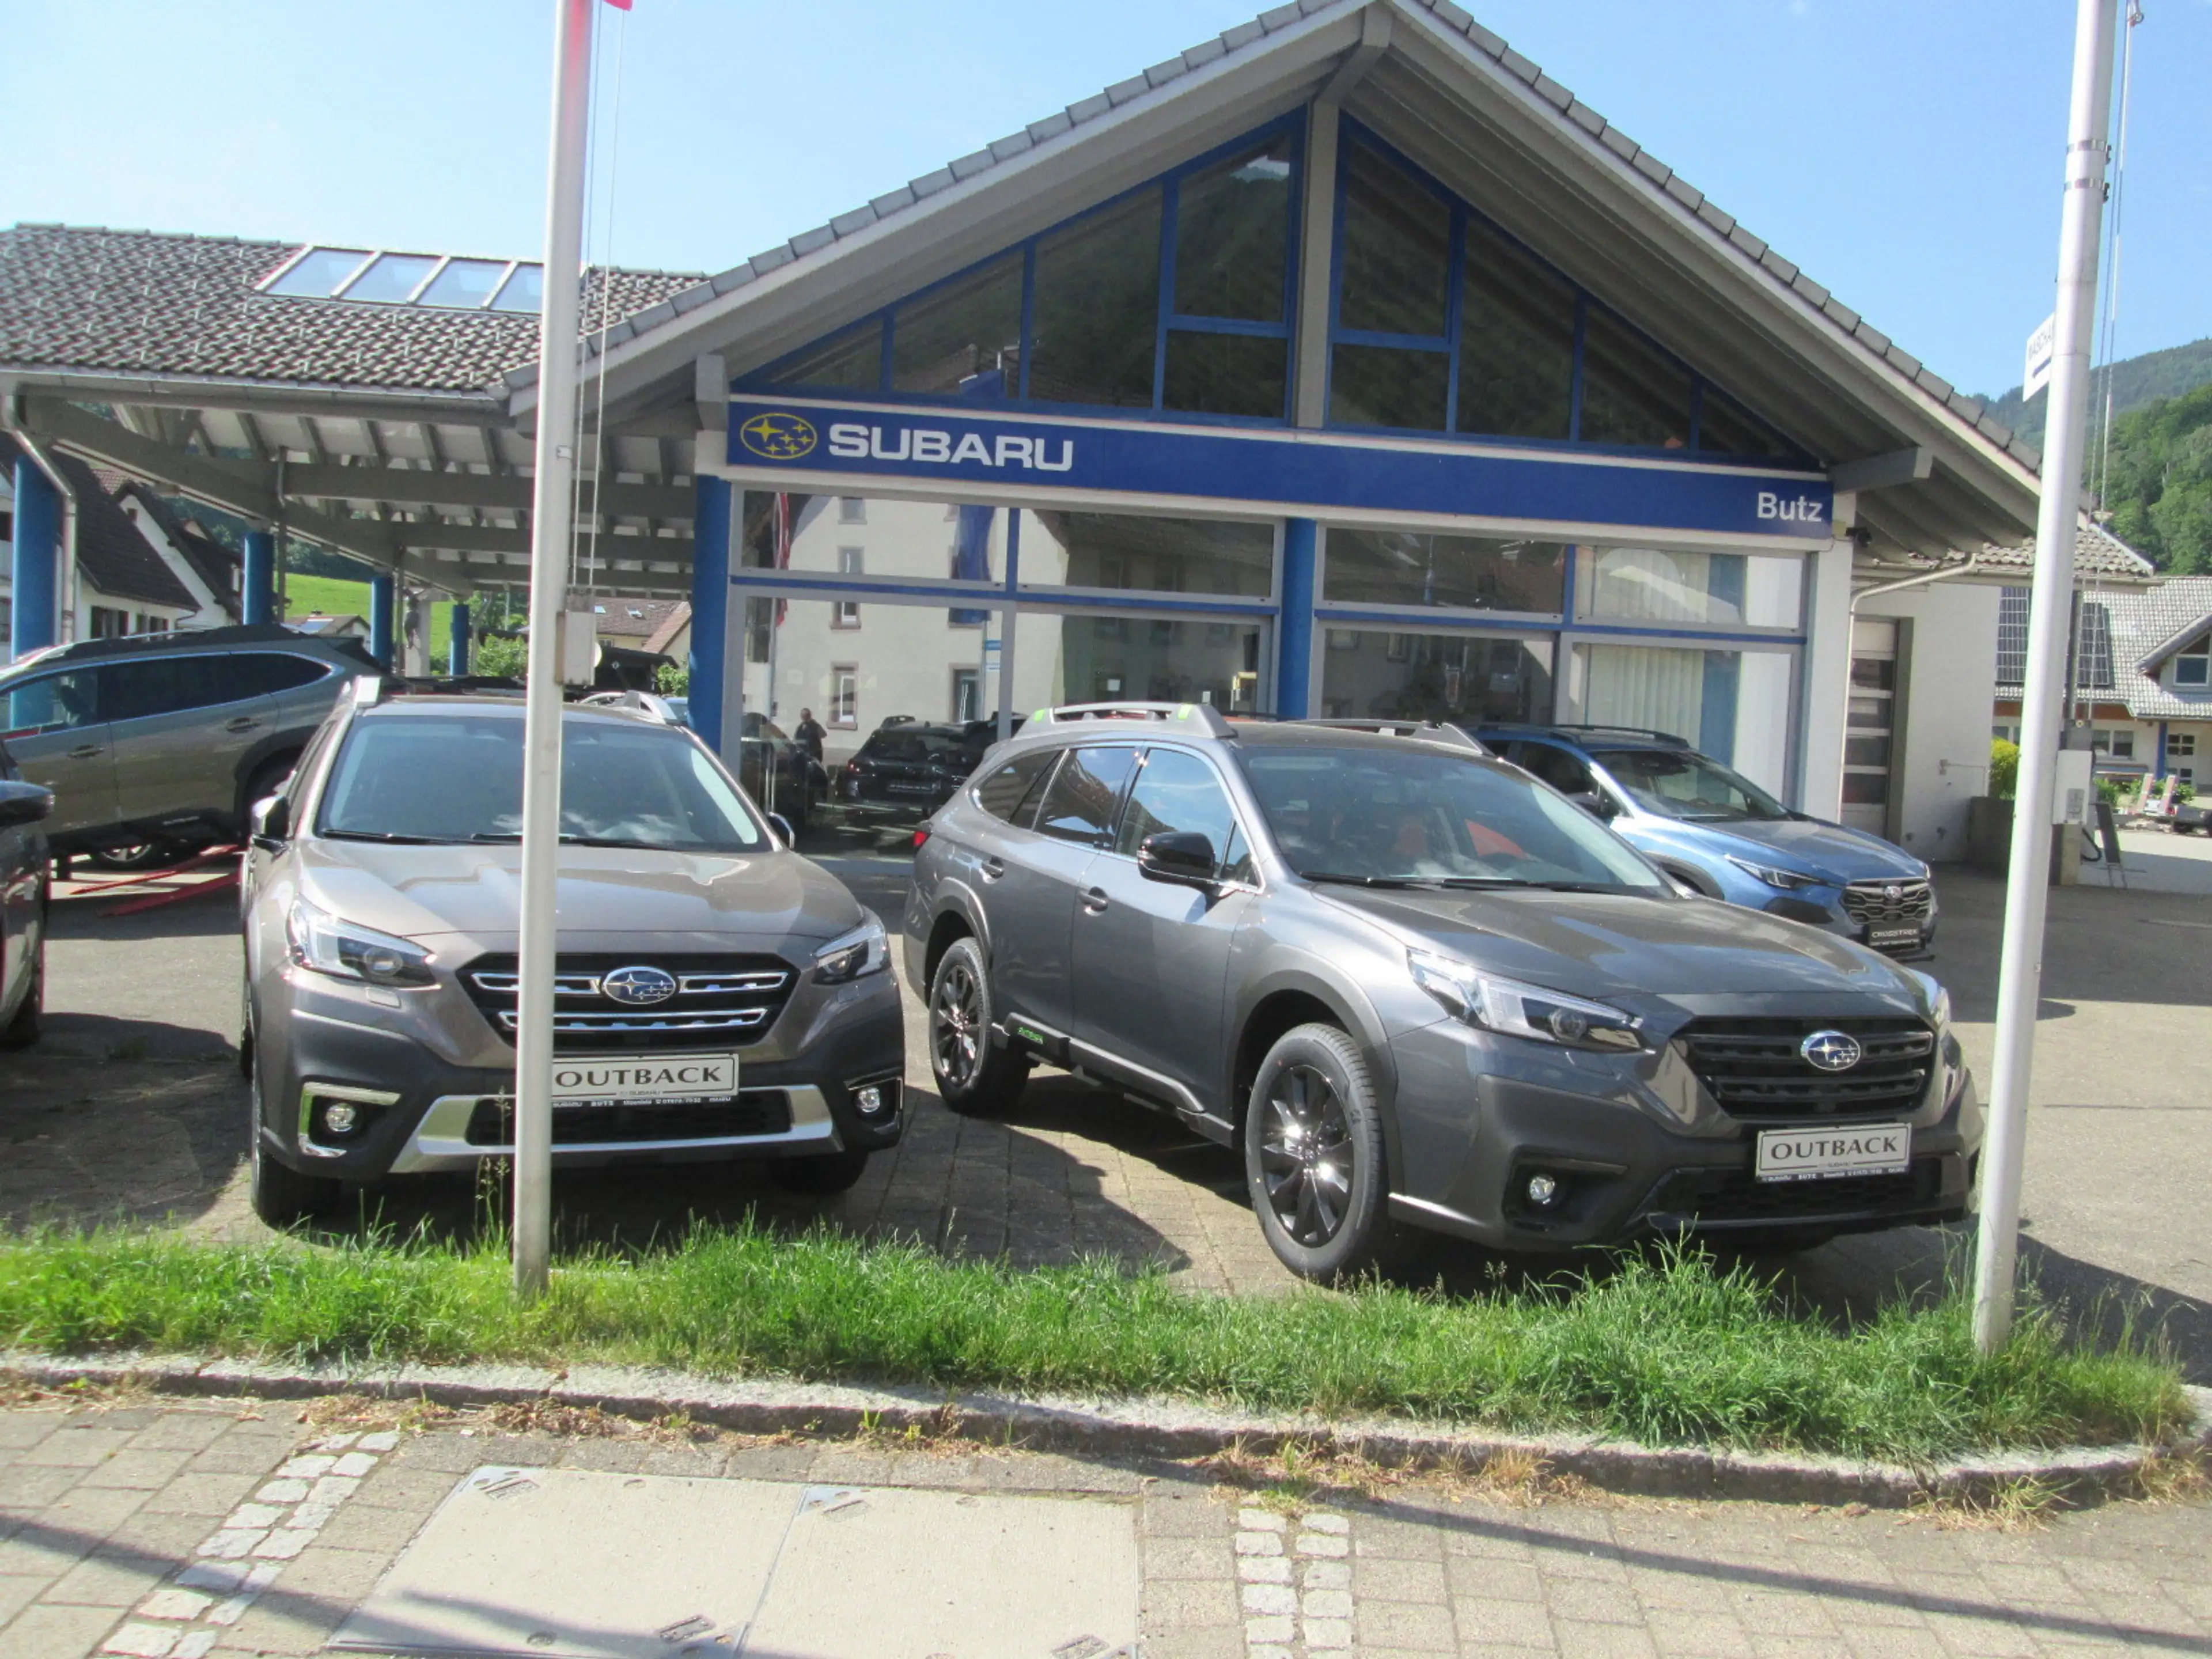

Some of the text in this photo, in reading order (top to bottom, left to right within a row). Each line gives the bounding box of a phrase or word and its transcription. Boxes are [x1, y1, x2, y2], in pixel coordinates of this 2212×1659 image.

[828, 423, 1074, 472] SUBARU
[1757, 492, 1823, 522] Butz
[555, 1066, 722, 1088] OUTBACK
[1771, 1136, 1898, 1160] OUTBACK
